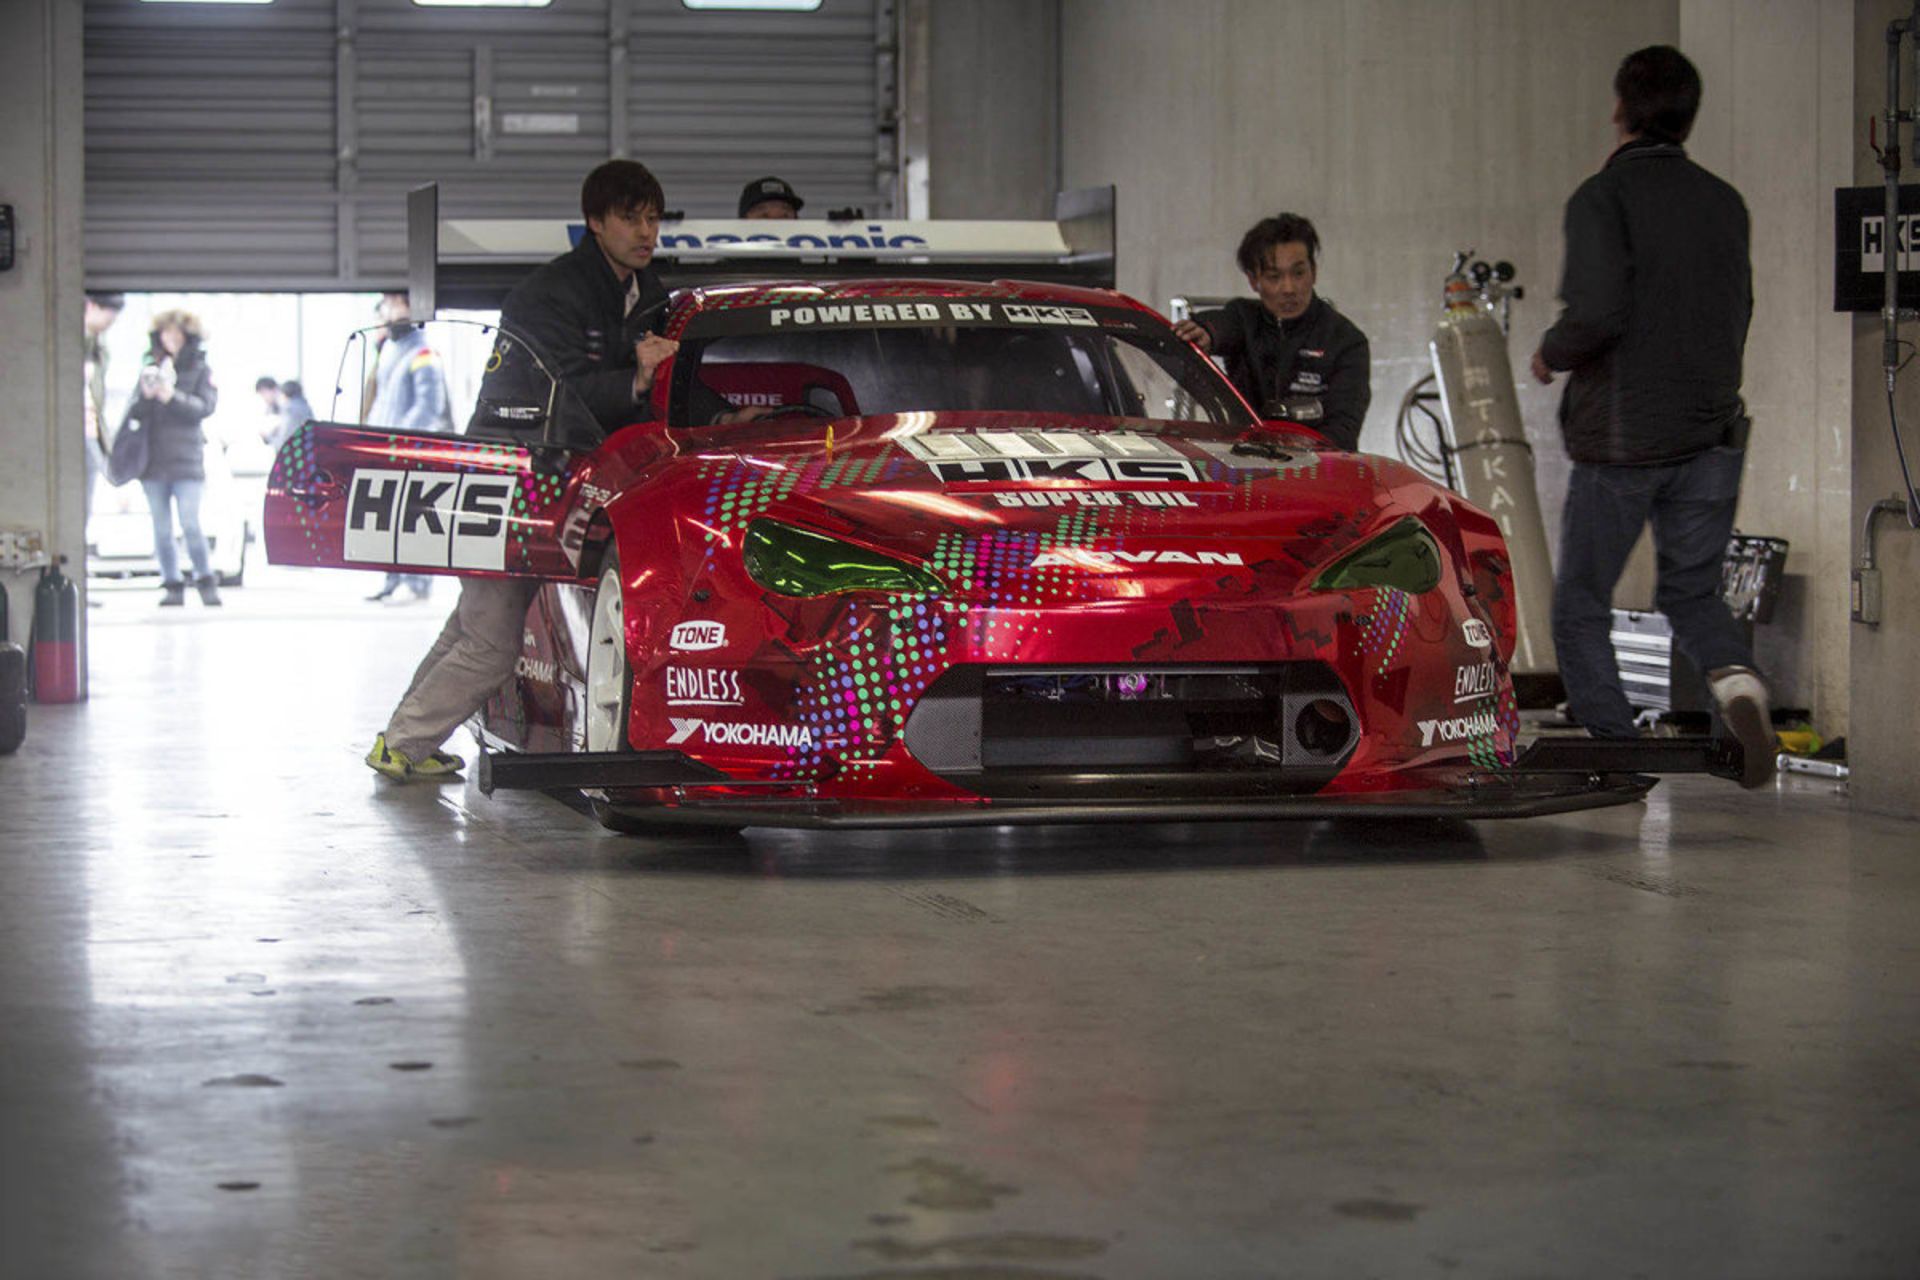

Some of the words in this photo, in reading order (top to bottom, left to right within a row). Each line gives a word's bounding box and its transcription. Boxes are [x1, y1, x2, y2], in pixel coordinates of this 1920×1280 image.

[567, 225, 928, 249] nasonic
[770, 304, 940, 326] POWERED
[949, 303, 992, 320] BY
[1003, 305, 1096, 325] HKS
[721, 393, 783, 406] RIDE
[934, 460, 1194, 482] HKS
[350, 478, 510, 537] HKS
[994, 491, 1123, 507] SUPER
[677, 626, 720, 643] TONE
[666, 666, 740, 700] ENDLESS
[701, 722, 813, 747] YOKOHAMA
[1436, 713, 1500, 741] YOKOHAMA
